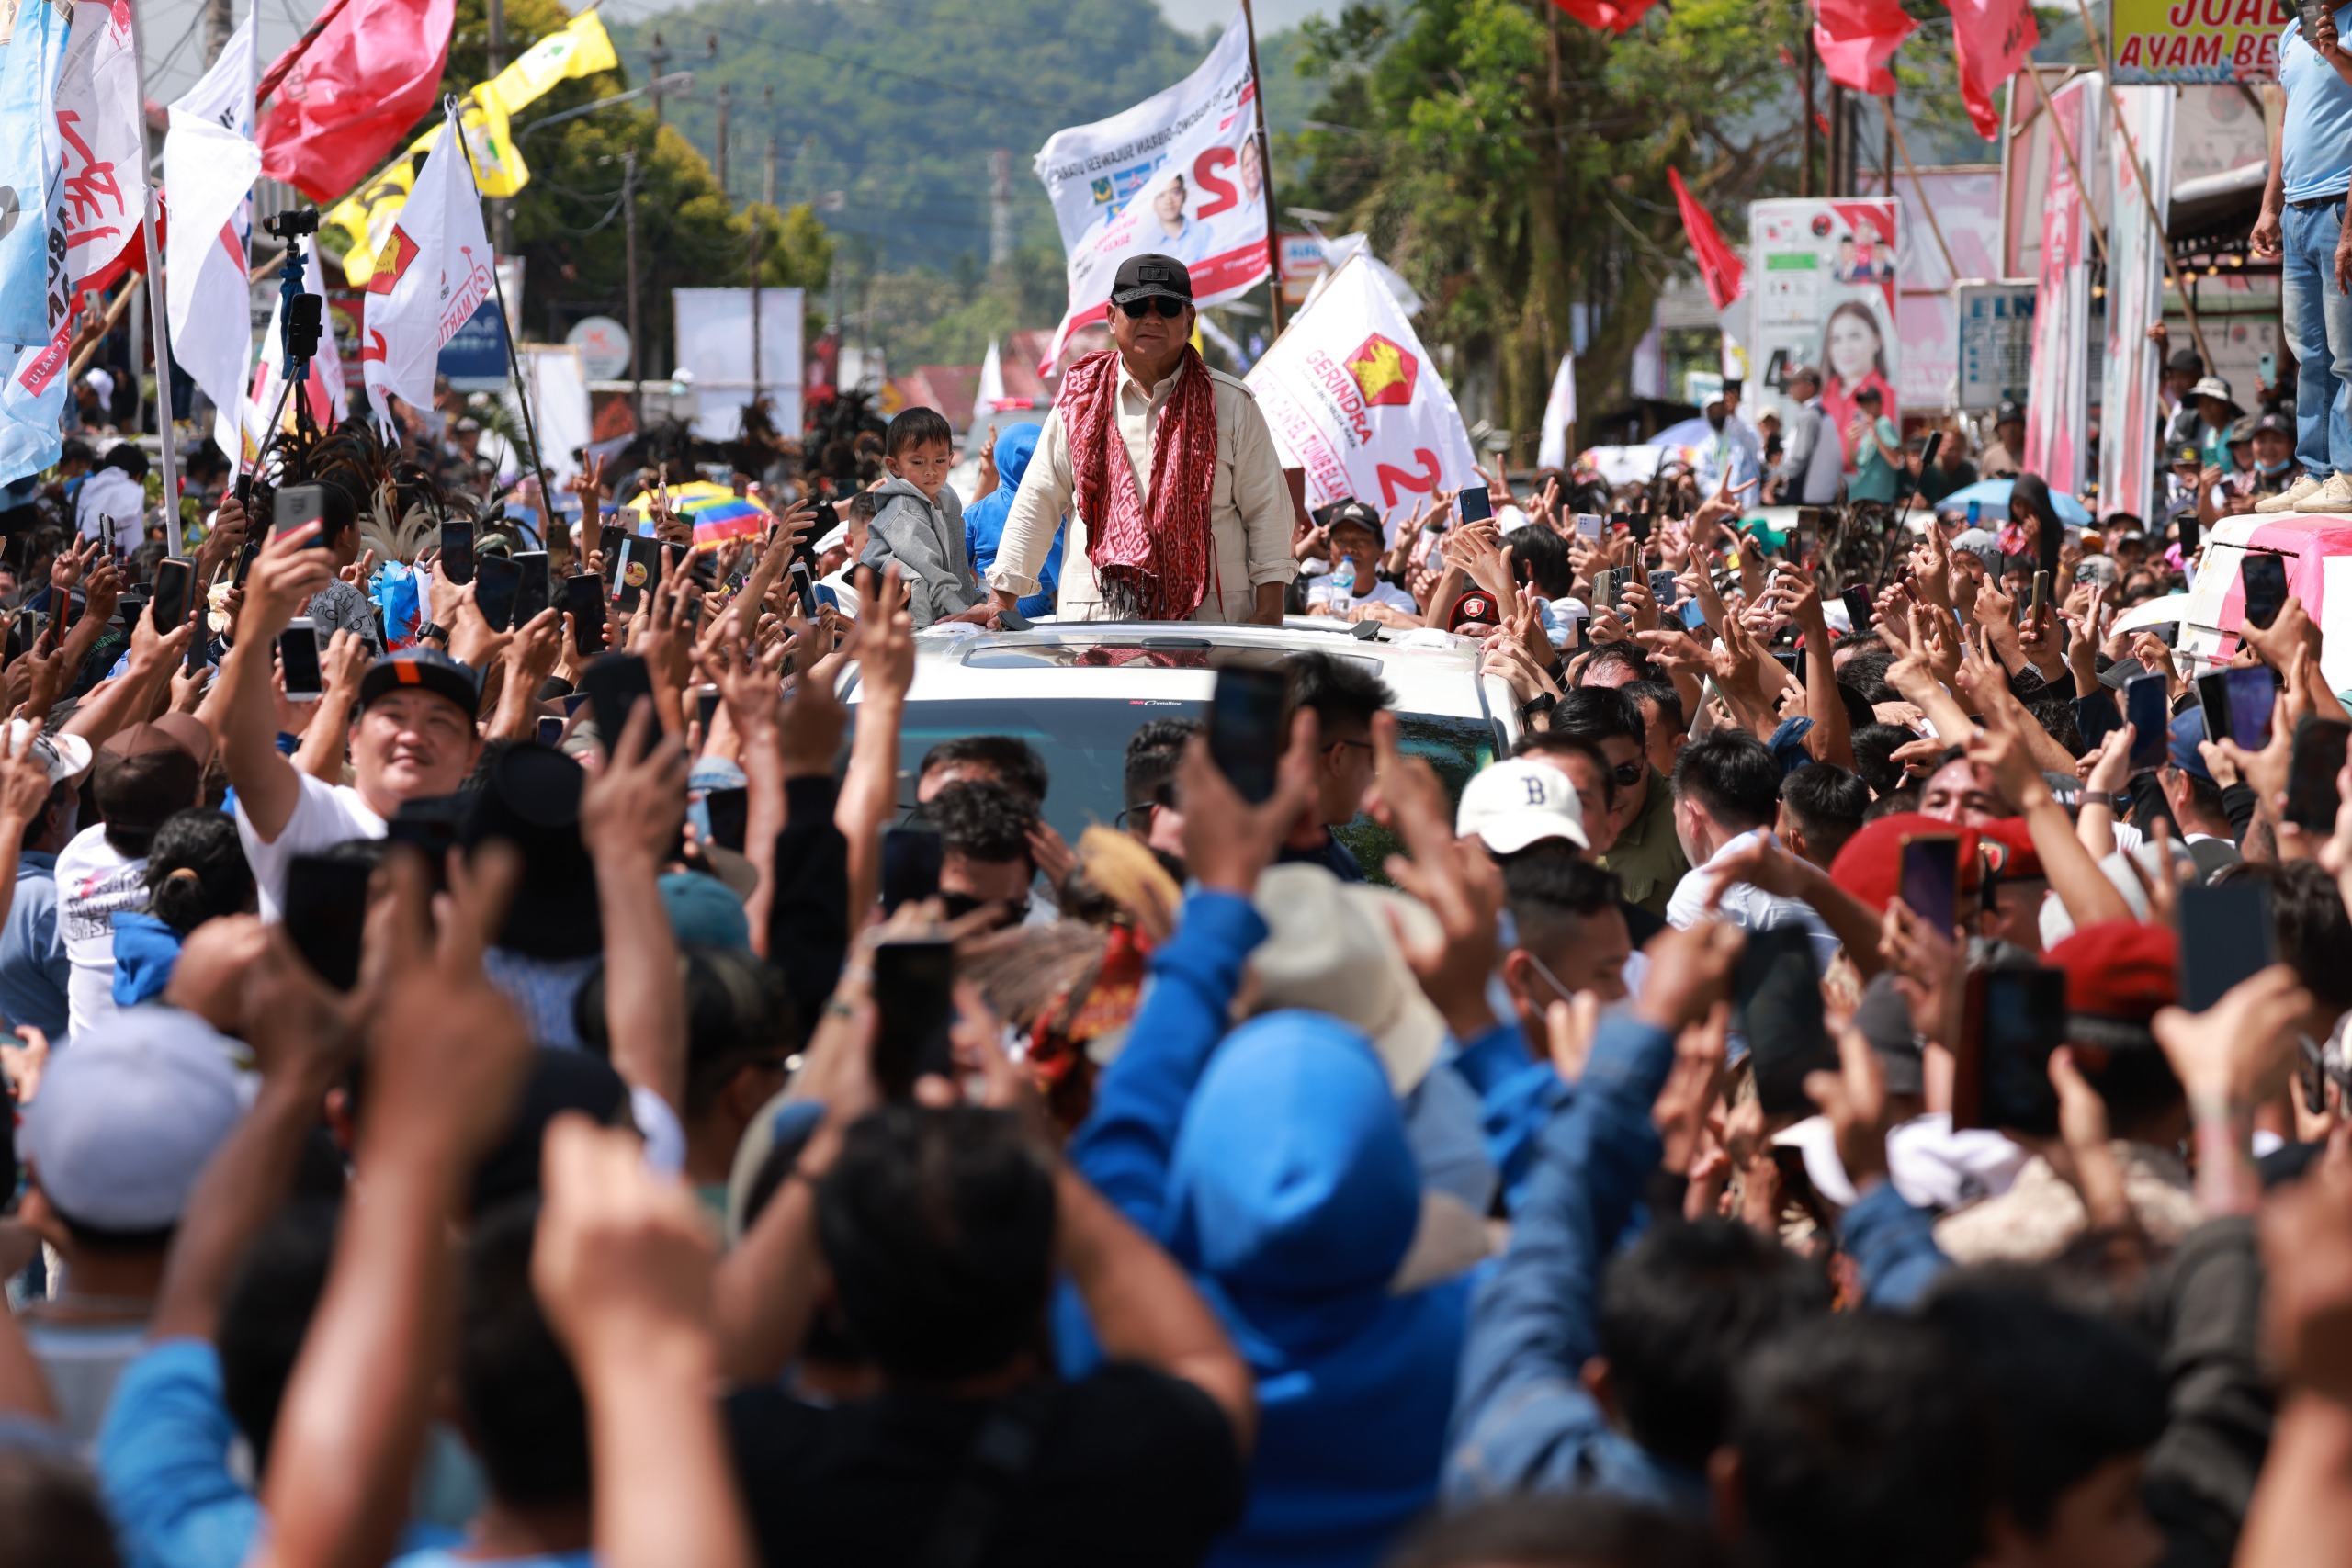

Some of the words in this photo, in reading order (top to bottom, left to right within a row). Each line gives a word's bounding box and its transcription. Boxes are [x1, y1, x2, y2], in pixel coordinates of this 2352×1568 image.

[2170, 0, 2290, 28] JUAL
[2119, 34, 2223, 68] AYAM
[2233, 33, 2282, 67] BE
[1306, 349, 1373, 446] GERINDRA
[1297, 434, 1350, 502] TUMBELAK
[1375, 447, 1442, 509] 2
[1521, 775, 1545, 806] B
